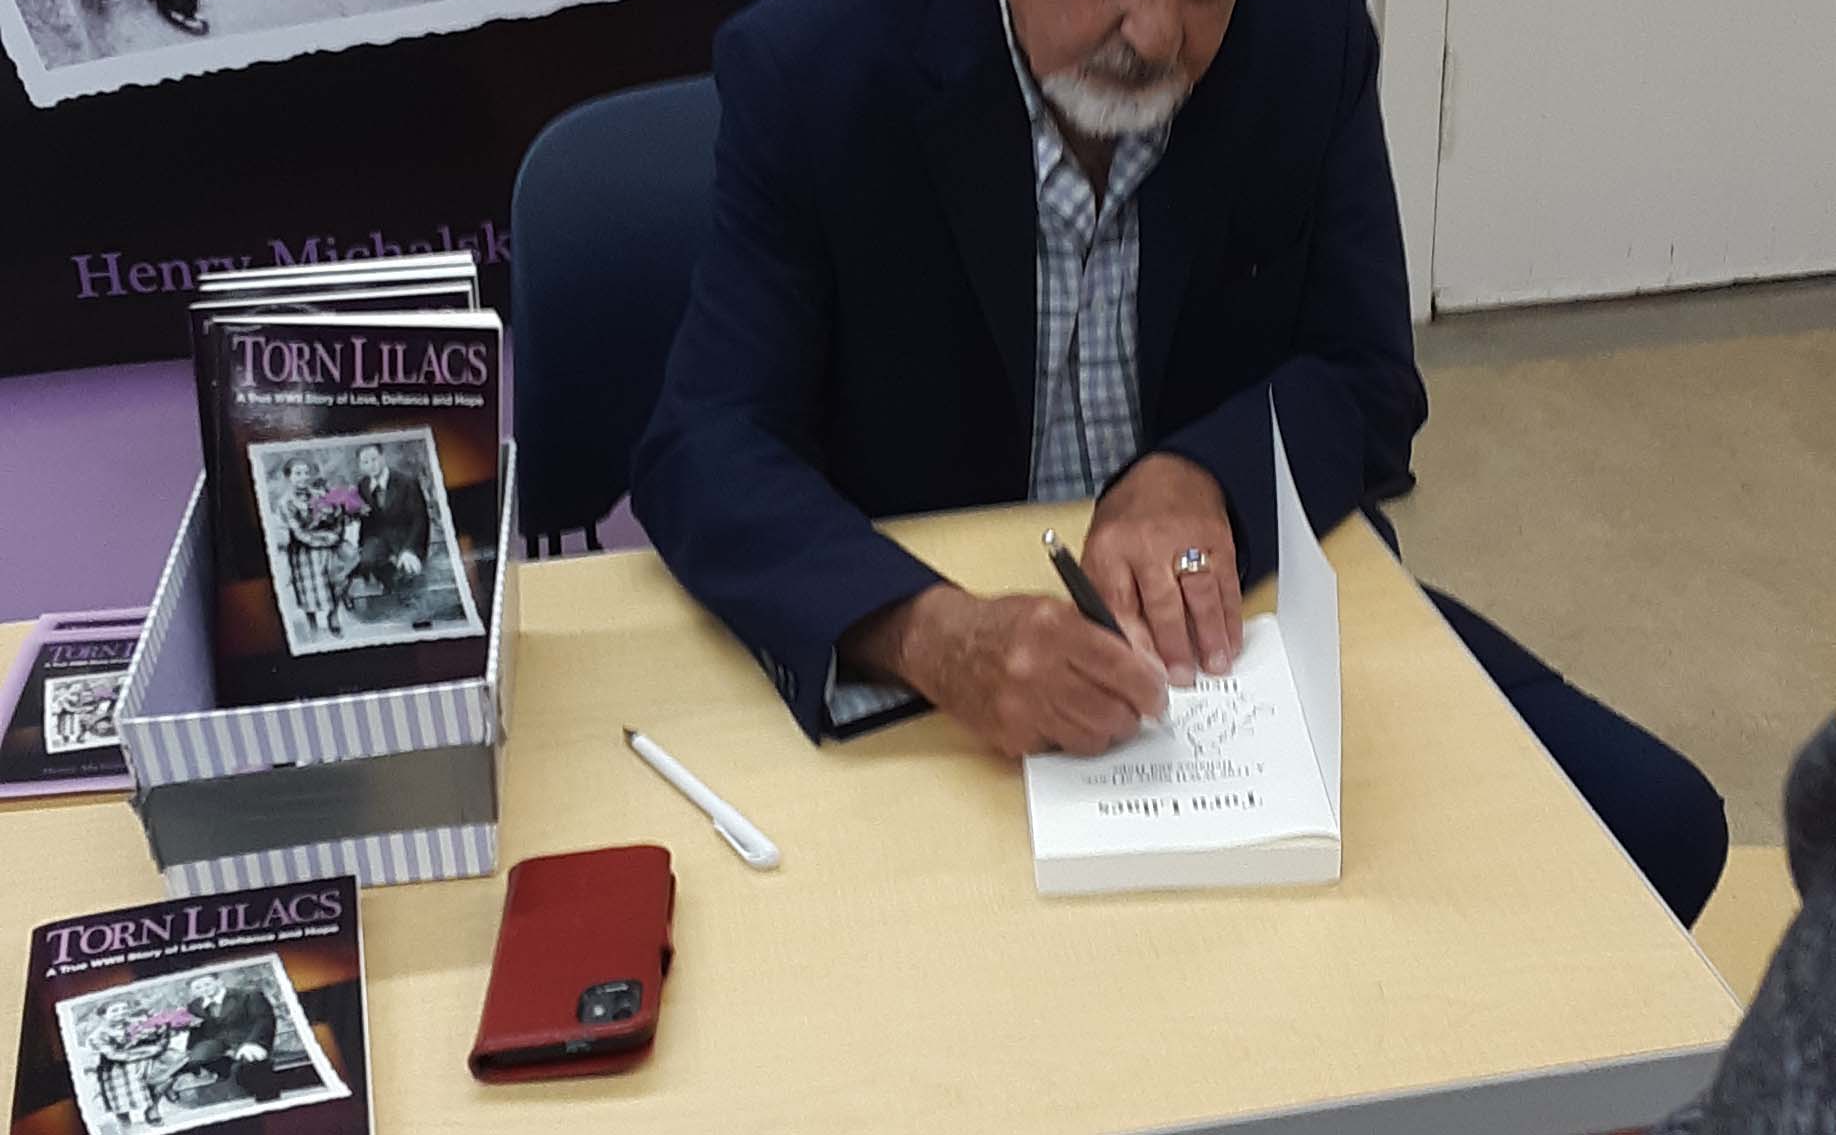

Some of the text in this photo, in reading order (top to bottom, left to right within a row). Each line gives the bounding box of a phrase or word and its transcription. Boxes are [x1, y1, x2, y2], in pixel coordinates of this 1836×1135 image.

[232, 335, 487, 388] TORN LILACS
[46, 890, 343, 965] TORN LILACS
